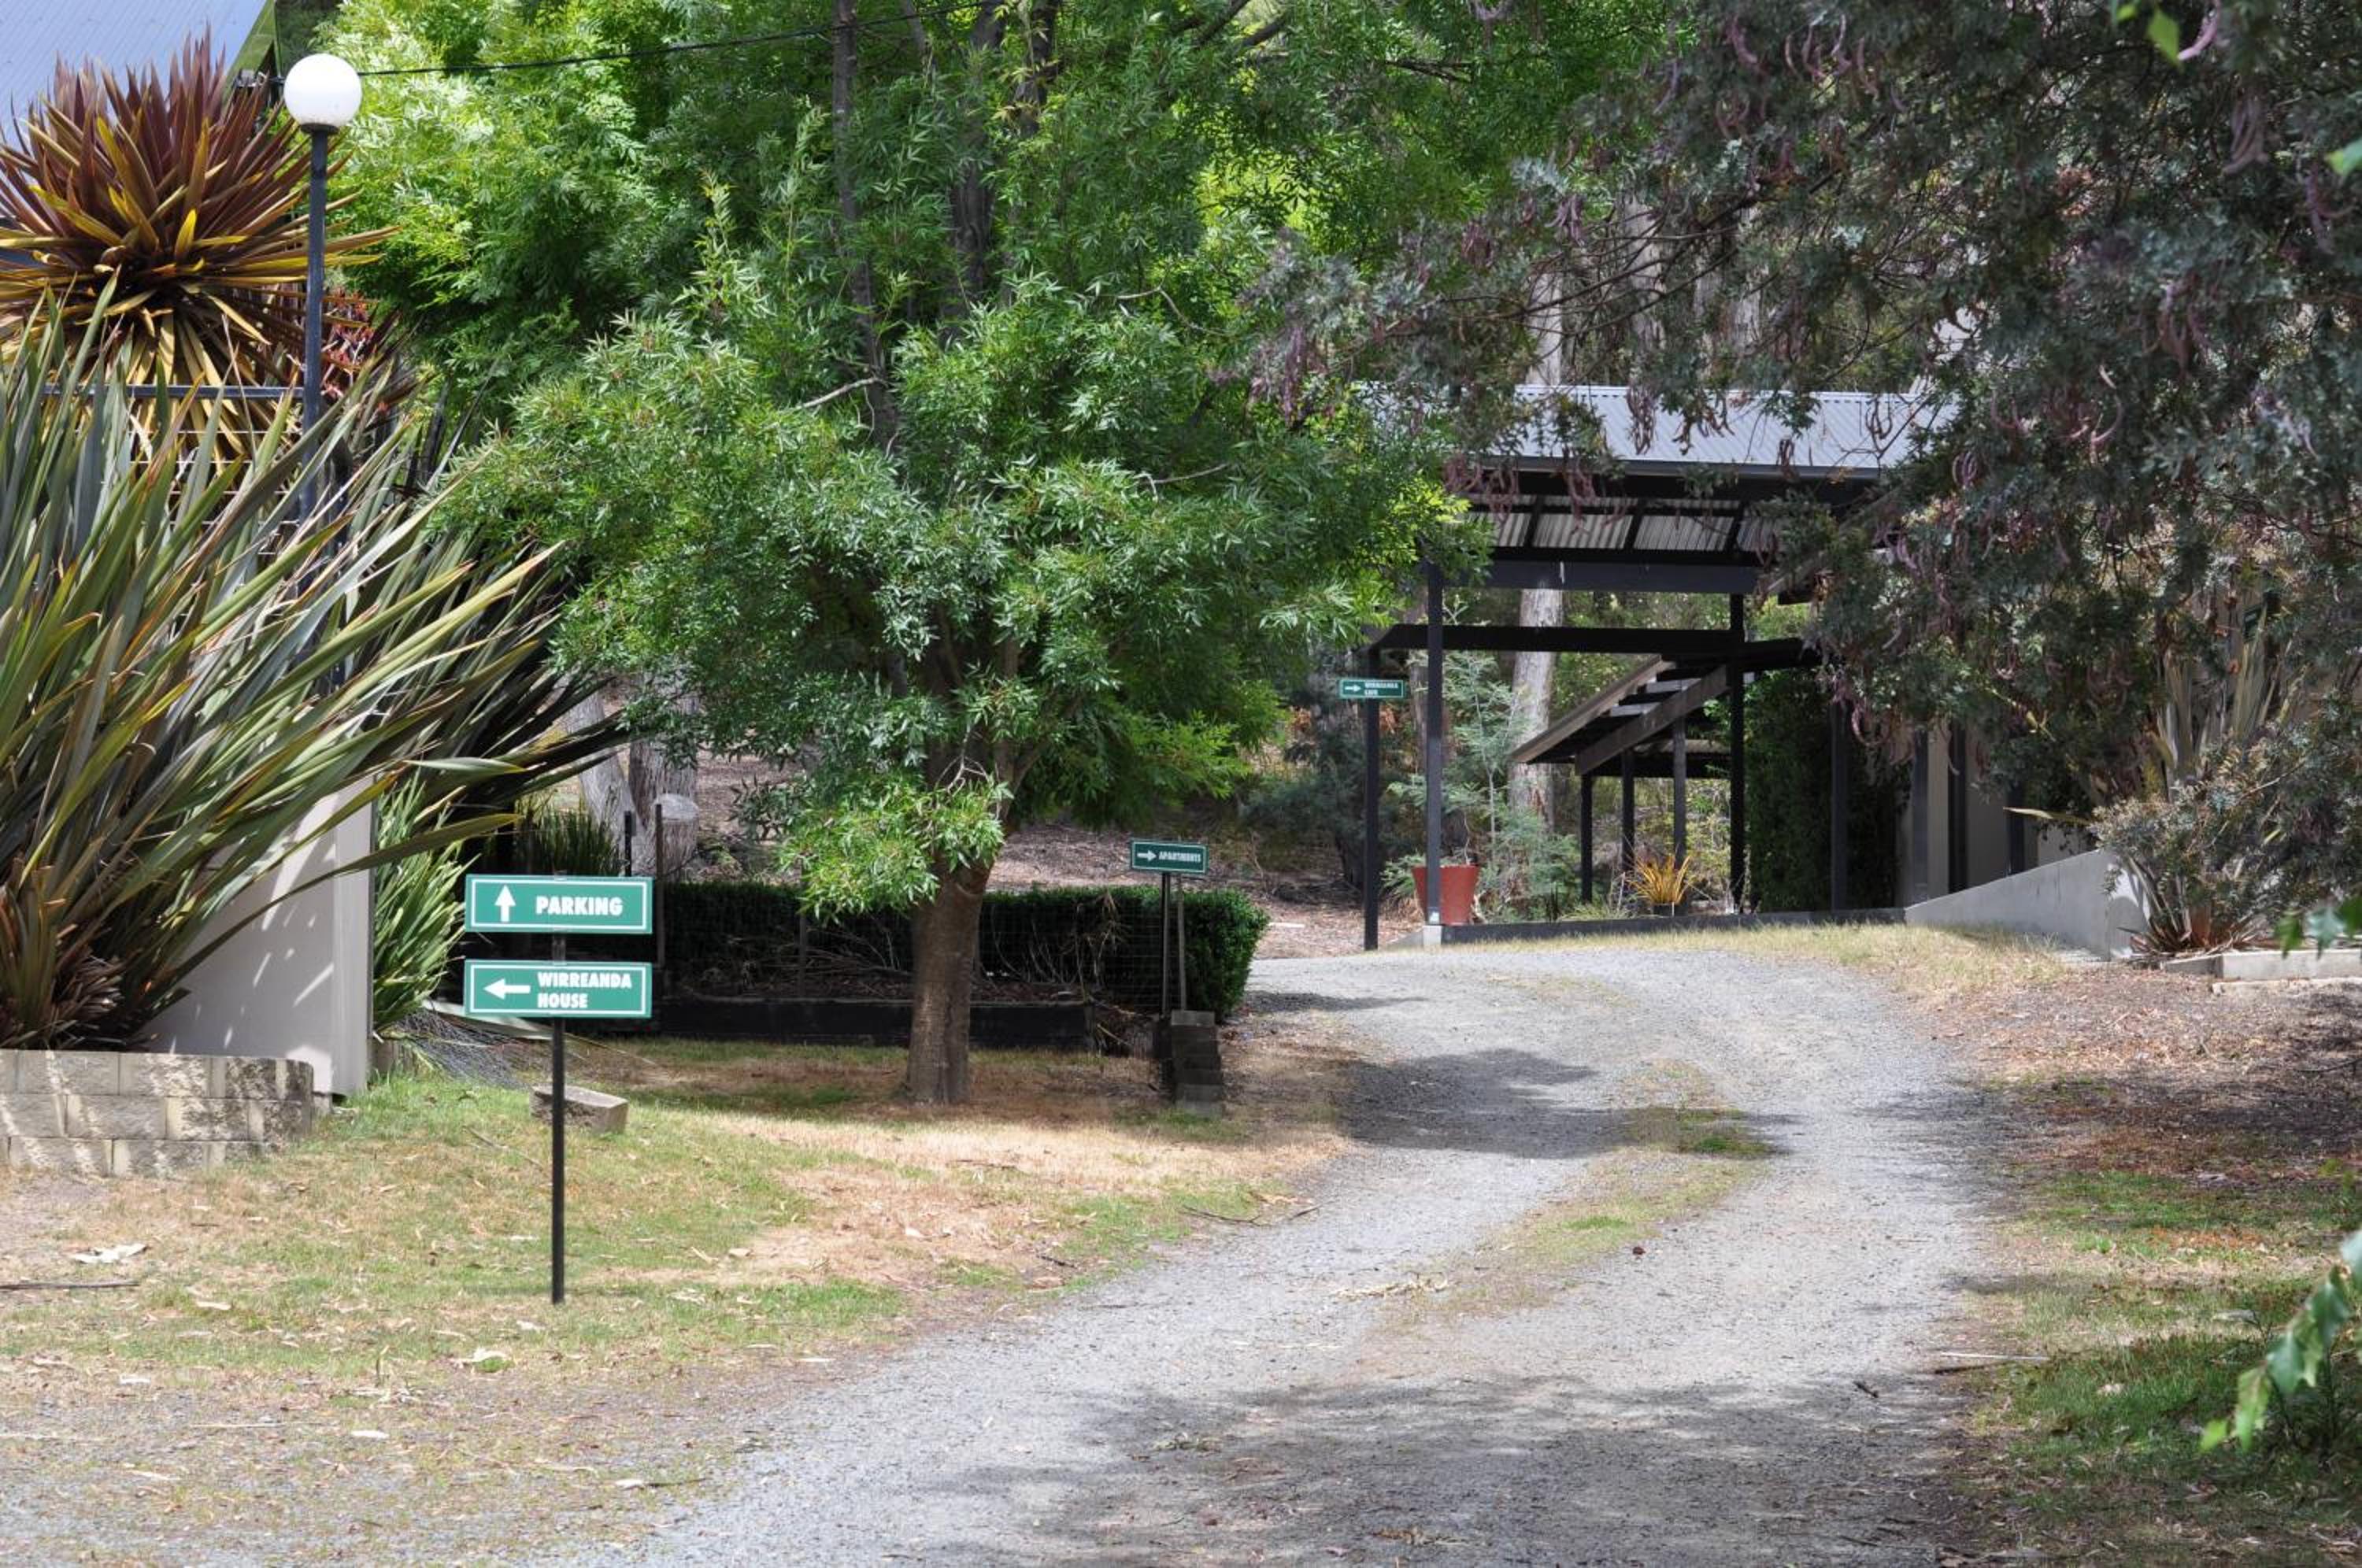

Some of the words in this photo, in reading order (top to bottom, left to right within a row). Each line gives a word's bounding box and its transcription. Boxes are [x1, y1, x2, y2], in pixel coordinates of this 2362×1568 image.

[535, 896, 624, 916] PARKING
[537, 971, 632, 989] WIRREANDA
[538, 992, 588, 1008] HOUSE
